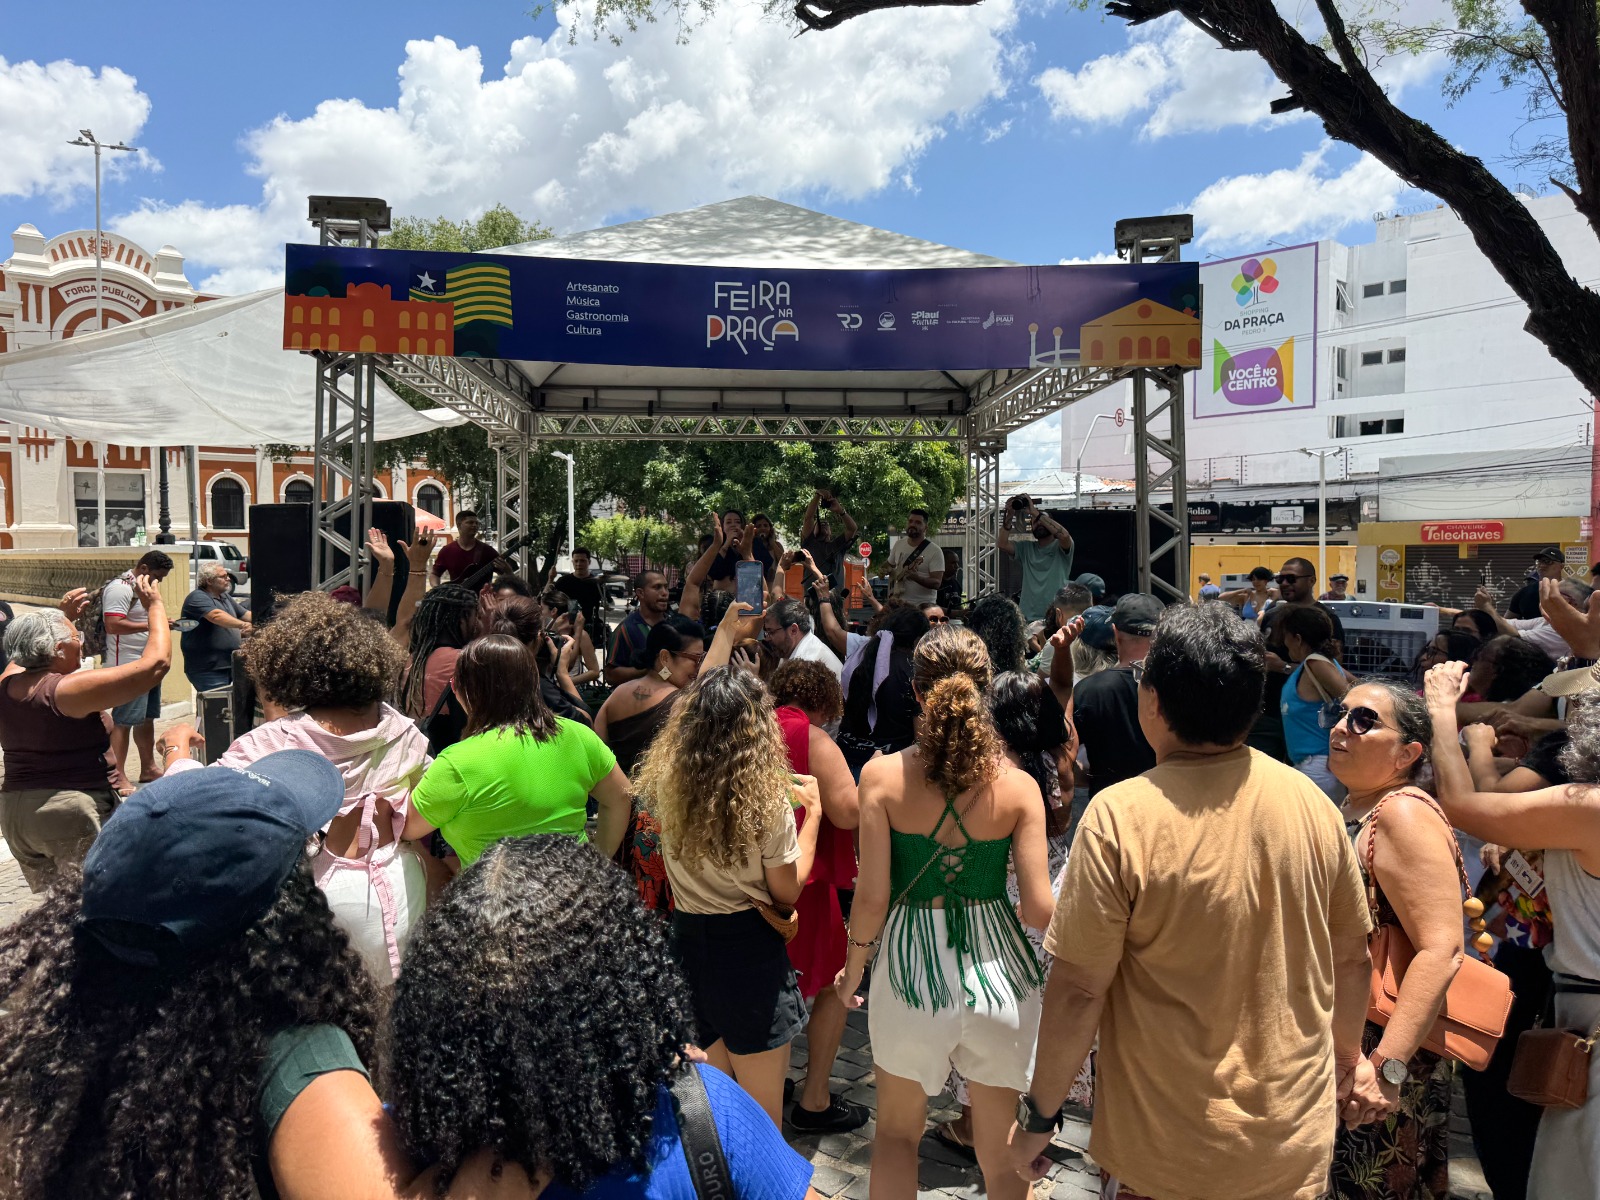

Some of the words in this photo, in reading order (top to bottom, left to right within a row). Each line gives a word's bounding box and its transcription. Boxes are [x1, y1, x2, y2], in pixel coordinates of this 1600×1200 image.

[566, 281, 620, 293] Artesanato
[65, 285, 97, 298] FORÇA
[102, 286, 141, 306] PUBLICA
[566, 295, 600, 308] Música
[714, 280, 790, 311] FEIRA
[566, 310, 630, 323] Gastronomia
[778, 308, 794, 318] NA
[1240, 307, 1269, 316] SHOPPING
[1224, 320, 1240, 332] DA
[1242, 312, 1284, 328] PRAÇA
[566, 323, 602, 336] Cultura
[707, 314, 800, 356] PRAÇA
[1228, 364, 1262, 380] VOCÊ
[1262, 368, 1278, 376] NO
[1228, 376, 1278, 391] CENTRO
[1423, 526, 1501, 540] Telechaves
